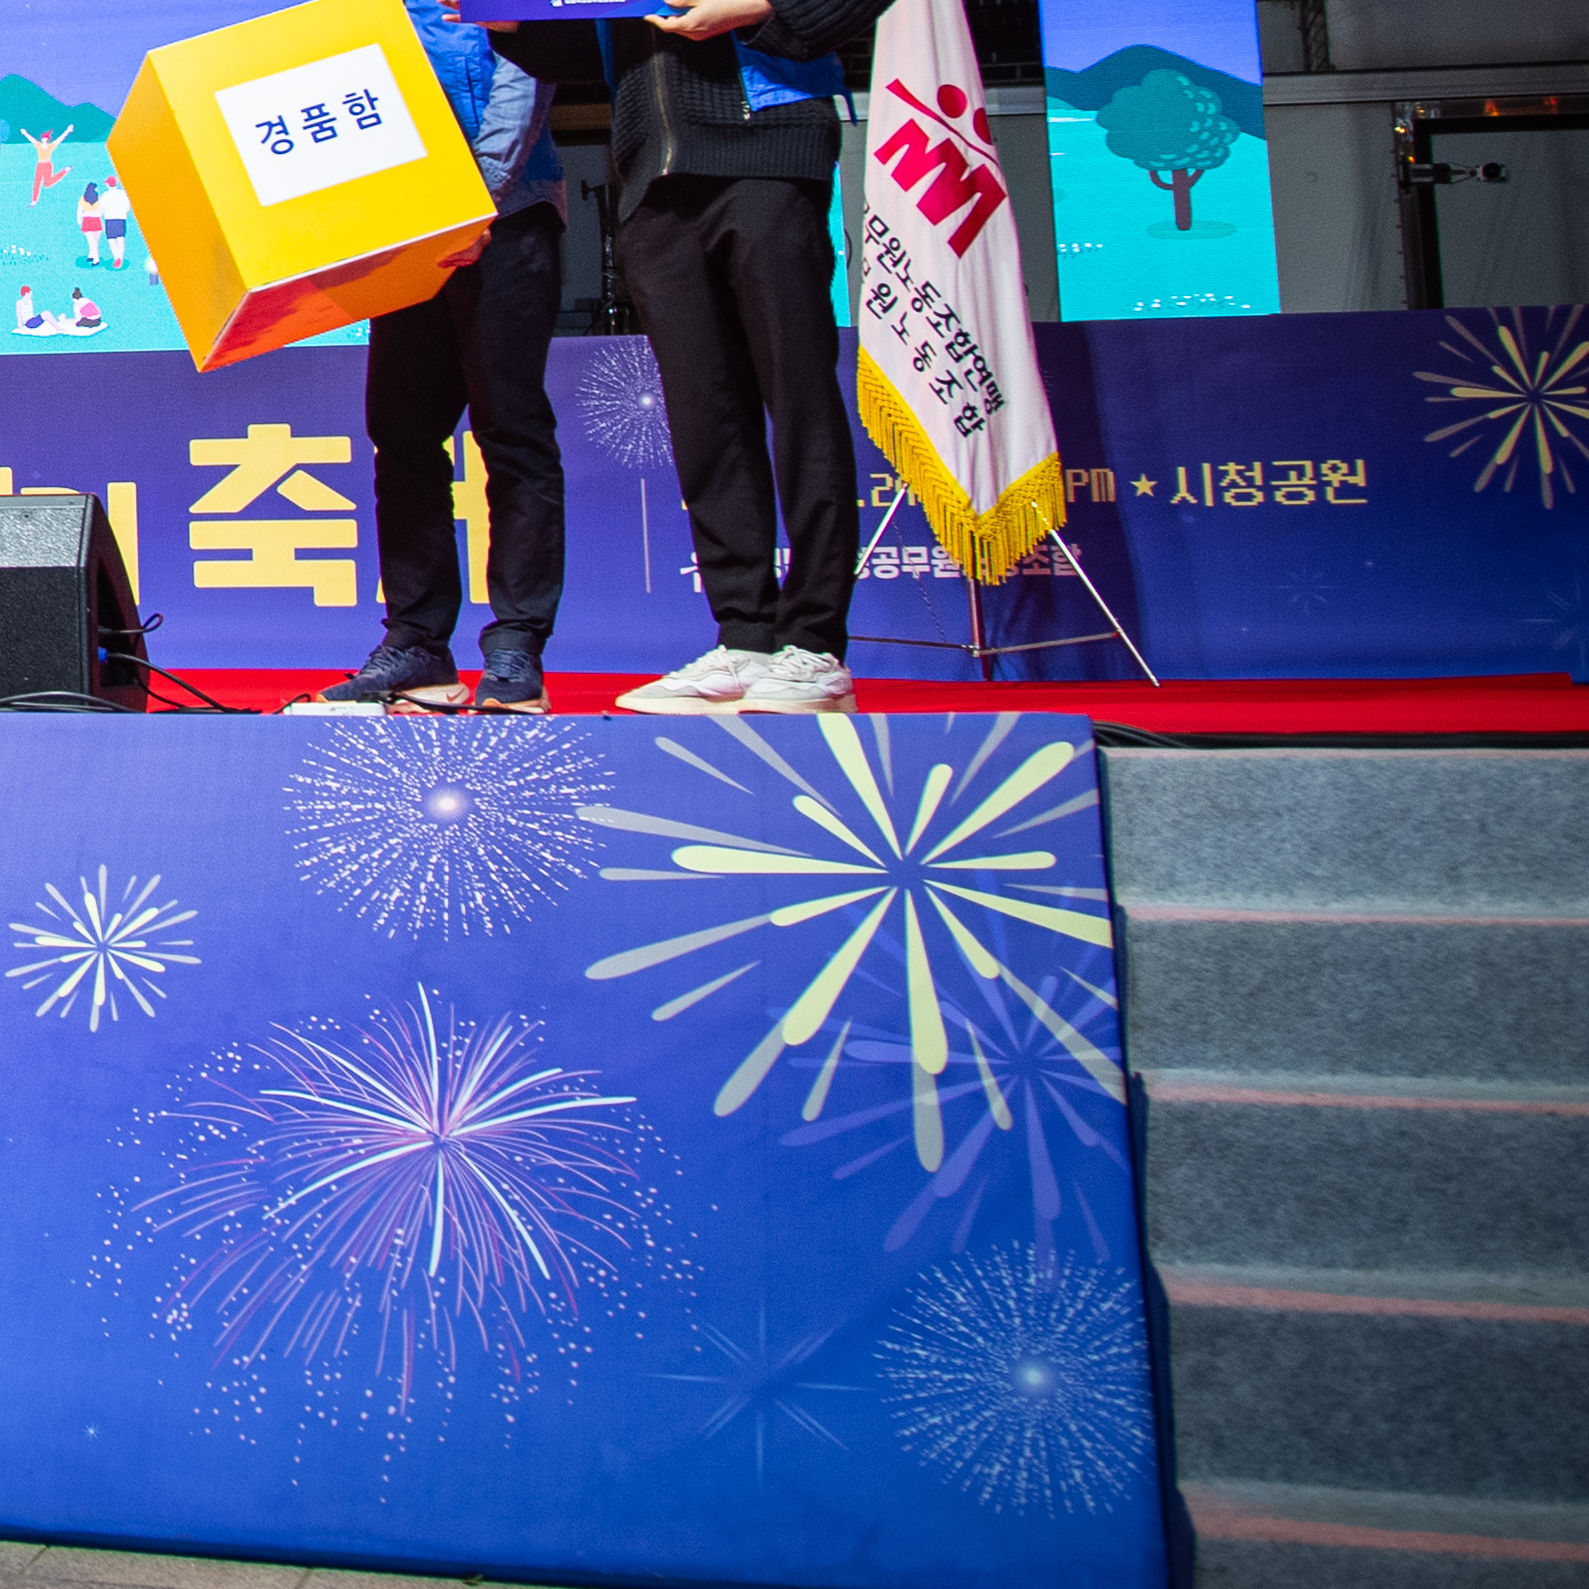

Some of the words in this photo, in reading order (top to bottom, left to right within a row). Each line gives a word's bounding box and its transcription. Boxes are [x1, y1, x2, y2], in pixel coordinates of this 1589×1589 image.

[253, 85, 383, 157] 경품함
[864, 201, 1006, 416] 무원노동조합연맹
[1066, 466, 1115, 504] PM
[1169, 459, 1369, 507] 시청공원
